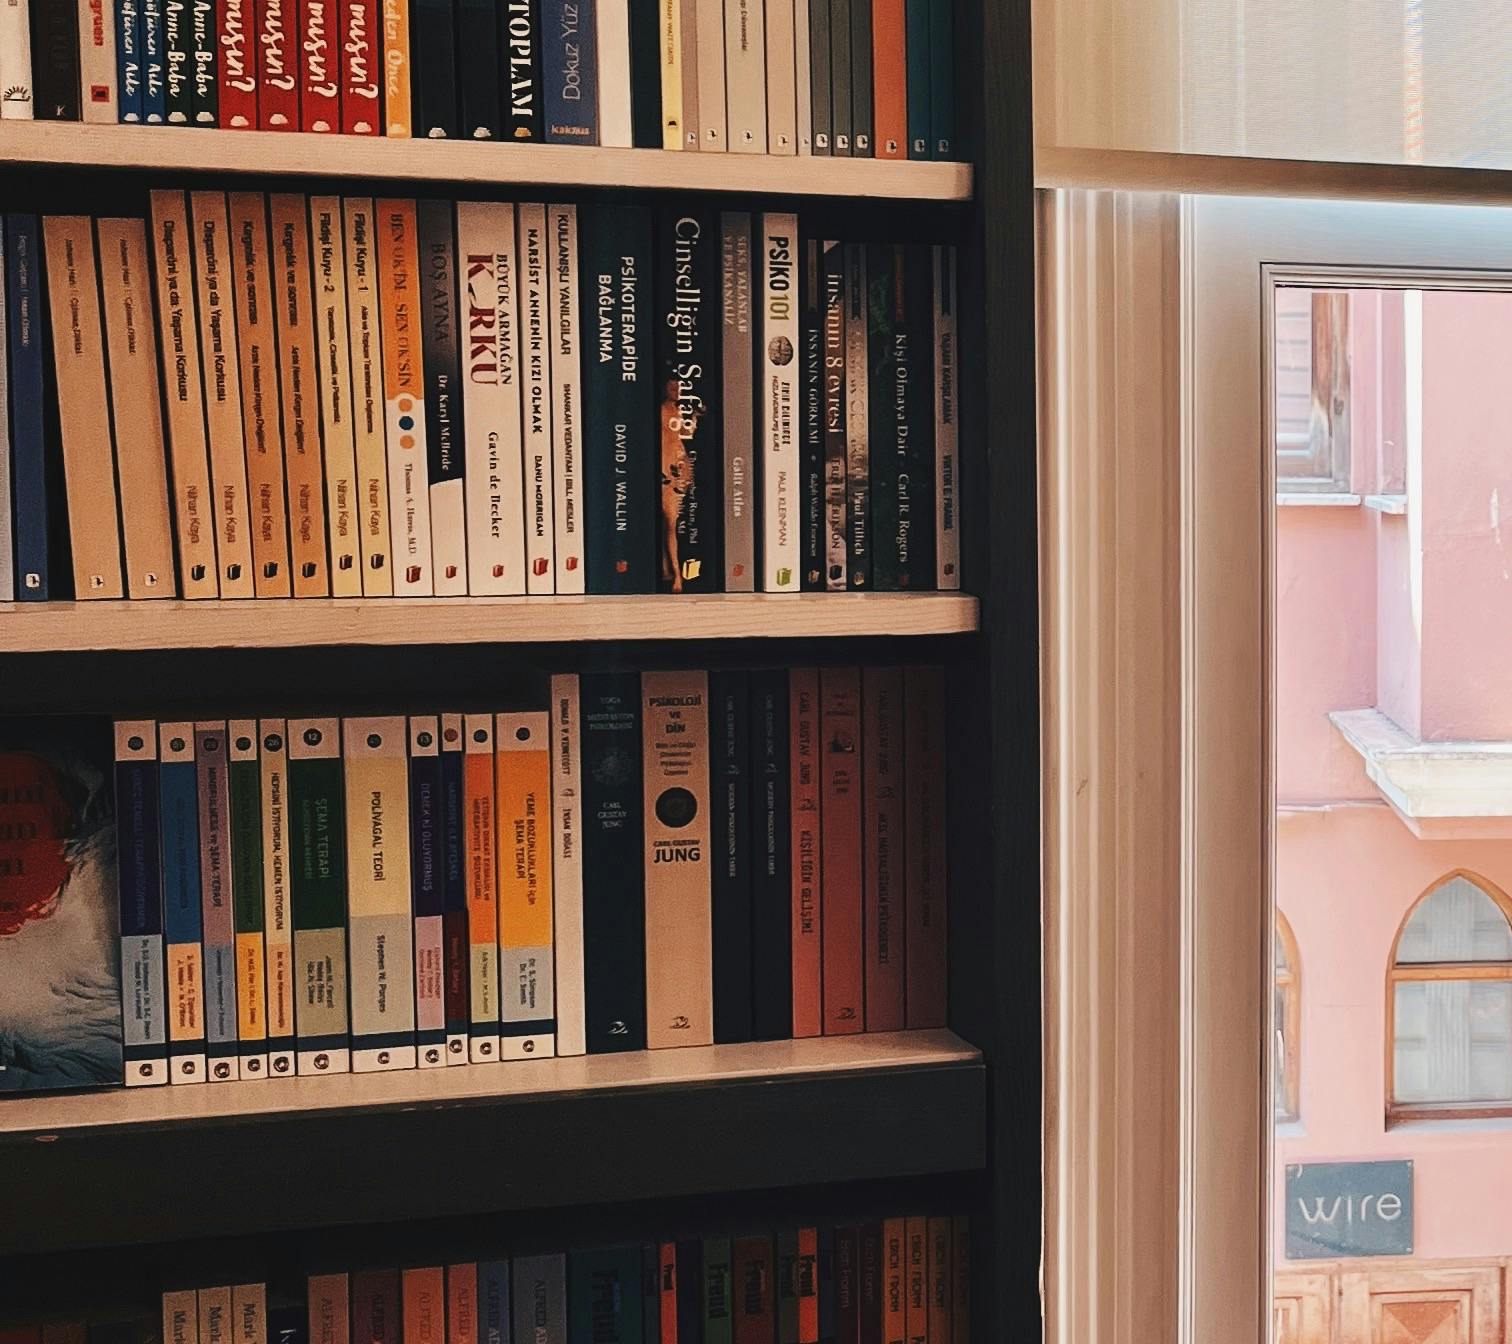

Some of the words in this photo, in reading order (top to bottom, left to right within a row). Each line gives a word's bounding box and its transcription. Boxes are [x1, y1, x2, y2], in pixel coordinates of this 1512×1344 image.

[88, 0, 106, 47] gruen
[562, 4, 580, 35] Yüz
[164, 0, 185, 98] Anne-Baba
[191, 0, 214, 98] Anne-Baba
[508, 0, 534, 117] TOPLAM
[563, 42, 582, 100] Dokuz
[526, 228, 544, 285] NARSİST
[767, 235, 794, 291] PSİKO
[496, 254, 513, 306] BÜYÜK
[665, 216, 702, 353] Cinselliğin
[528, 289, 546, 350] ANNENİN
[558, 286, 574, 356] YANILGILAR
[597, 273, 617, 363] BAĞLANMA
[619, 256, 640, 382] PSİKOTERAPİDE
[769, 294, 791, 321] 101
[498, 309, 516, 385] ARMAĞAN
[529, 355, 543, 381] KIZI
[530, 386, 544, 434] OLMAK
[666, 362, 703, 443] Şafağı
[893, 366, 909, 421] Olmaya
[486, 431, 501, 470] Gavin
[614, 424, 628, 463] DAVID
[223, 485, 237, 514] Nihan
[368, 478, 382, 508] Nihan
[488, 474, 501, 490] de
[777, 470, 788, 495] PAUL
[853, 491, 866, 515] Paul
[897, 473, 910, 500] Carl
[369, 510, 383, 536] Kaya
[488, 494, 503, 539] Becker
[614, 481, 627, 532] WALLIN
[224, 517, 239, 543] Kaya
[853, 517, 866, 555] Tillich
[895, 520, 911, 563] Rogers
[370, 791, 384, 848] POLİVAGAL
[372, 851, 386, 882] TEORİ
[653, 847, 701, 864] JUNG
[1298, 1193, 1402, 1224] wire
[208, 1306, 223, 1341] Mark
[242, 1302, 258, 1338] Mark
